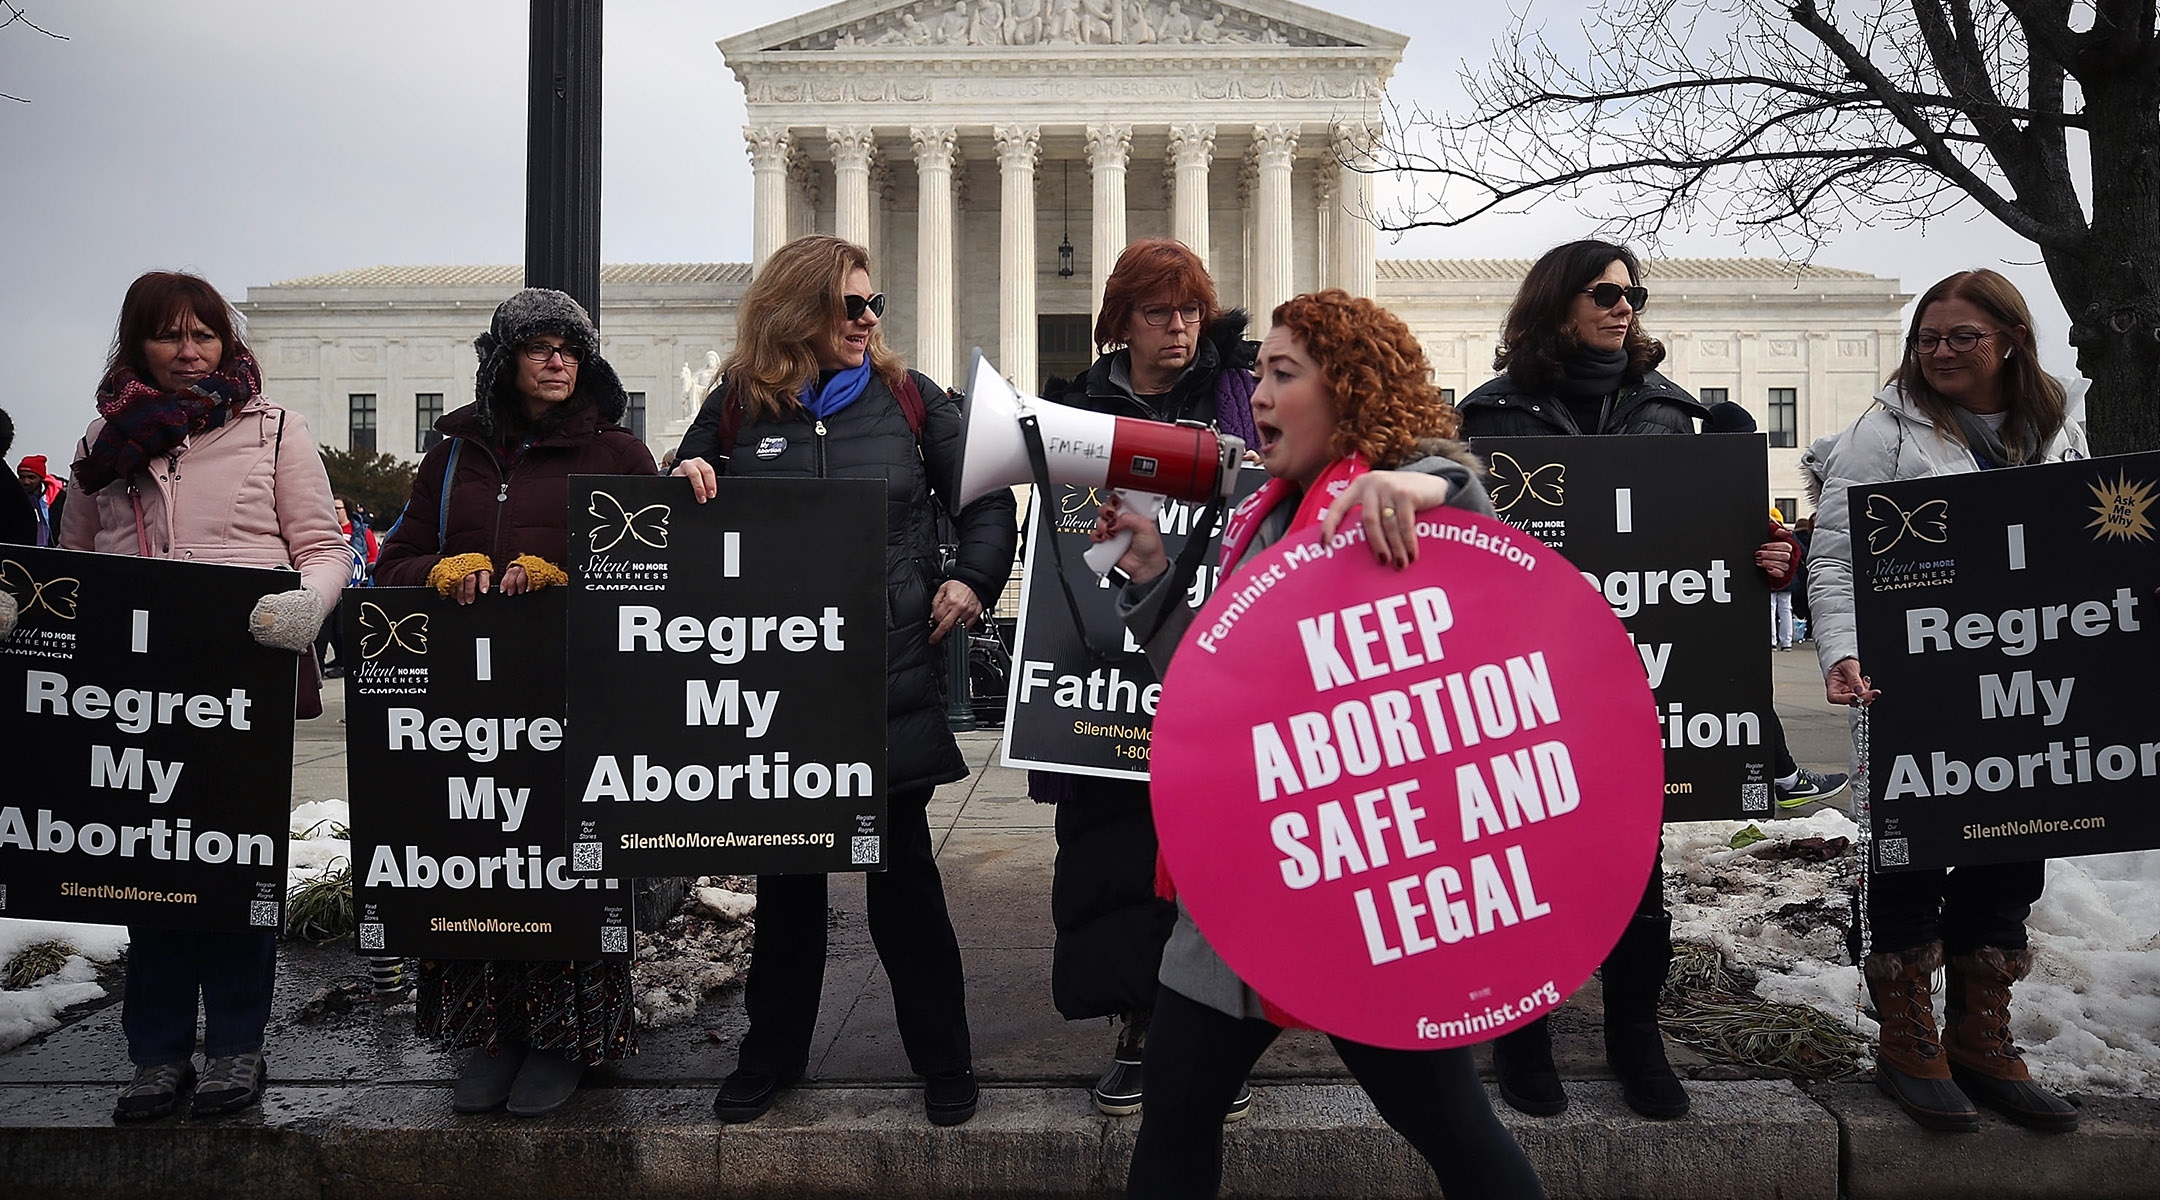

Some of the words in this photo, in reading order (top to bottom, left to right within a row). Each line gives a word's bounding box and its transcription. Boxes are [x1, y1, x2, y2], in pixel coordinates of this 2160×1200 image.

[944, 81, 1005, 98] EQUAL
[1085, 82, 1141, 96] UNDER
[1148, 82, 1181, 96] LAW
[1615, 488, 1633, 533] I
[2108, 513, 2134, 529] Why
[2112, 505, 2132, 517] Me
[2113, 495, 2136, 507] Ask
[1532, 521, 1543, 529] NO
[1544, 521, 1566, 529] MORE
[2007, 524, 2026, 571] I
[579, 554, 631, 573] Silent
[632, 563, 645, 571] NO
[646, 563, 669, 571] MORE
[723, 532, 741, 578] I
[1866, 558, 1916, 577] Silent
[1919, 562, 1932, 570] NO
[1933, 560, 1955, 568] MORE
[1872, 569, 1956, 585] AWARENESS
[1197, 562, 1286, 655] Feminist
[1283, 522, 1367, 571] Majori
[1413, 520, 1538, 572] oundation
[1580, 560, 1732, 618] gret
[1873, 578, 1954, 592] CAMPAIGN
[4, 637, 77, 650] WARENESS
[41, 631, 54, 639] NO
[54, 632, 77, 641] MORE
[132, 609, 149, 653] I
[618, 605, 845, 664] Regret
[1297, 586, 1455, 693] KEEP
[1906, 588, 2141, 657] Regret
[353, 661, 397, 677] Silent
[398, 668, 409, 676] NO
[409, 668, 429, 676] MORE
[476, 637, 491, 681] I
[26, 669, 251, 734] Regret
[686, 679, 780, 738] My
[1020, 660, 1163, 717] Fathe
[1979, 670, 2075, 726] My
[387, 708, 568, 763] Regre
[1251, 650, 1562, 803] ABORTION
[90, 745, 184, 804] My
[582, 751, 873, 803] Abortion
[448, 776, 531, 832] My
[1270, 778, 1437, 891] SAFE
[1454, 739, 1582, 843] AND
[0, 806, 275, 867] Abortion
[620, 831, 835, 850] SilentNoMoreAwareness.org
[1963, 815, 2106, 840] SilentNoMore.com
[365, 845, 620, 890] Abortio
[60, 882, 198, 904] SilentNoMore.com
[1353, 844, 1552, 967] LEGAL
[430, 918, 552, 934] SilentNoMore.com
[1416, 979, 1561, 1041] feminist.org
